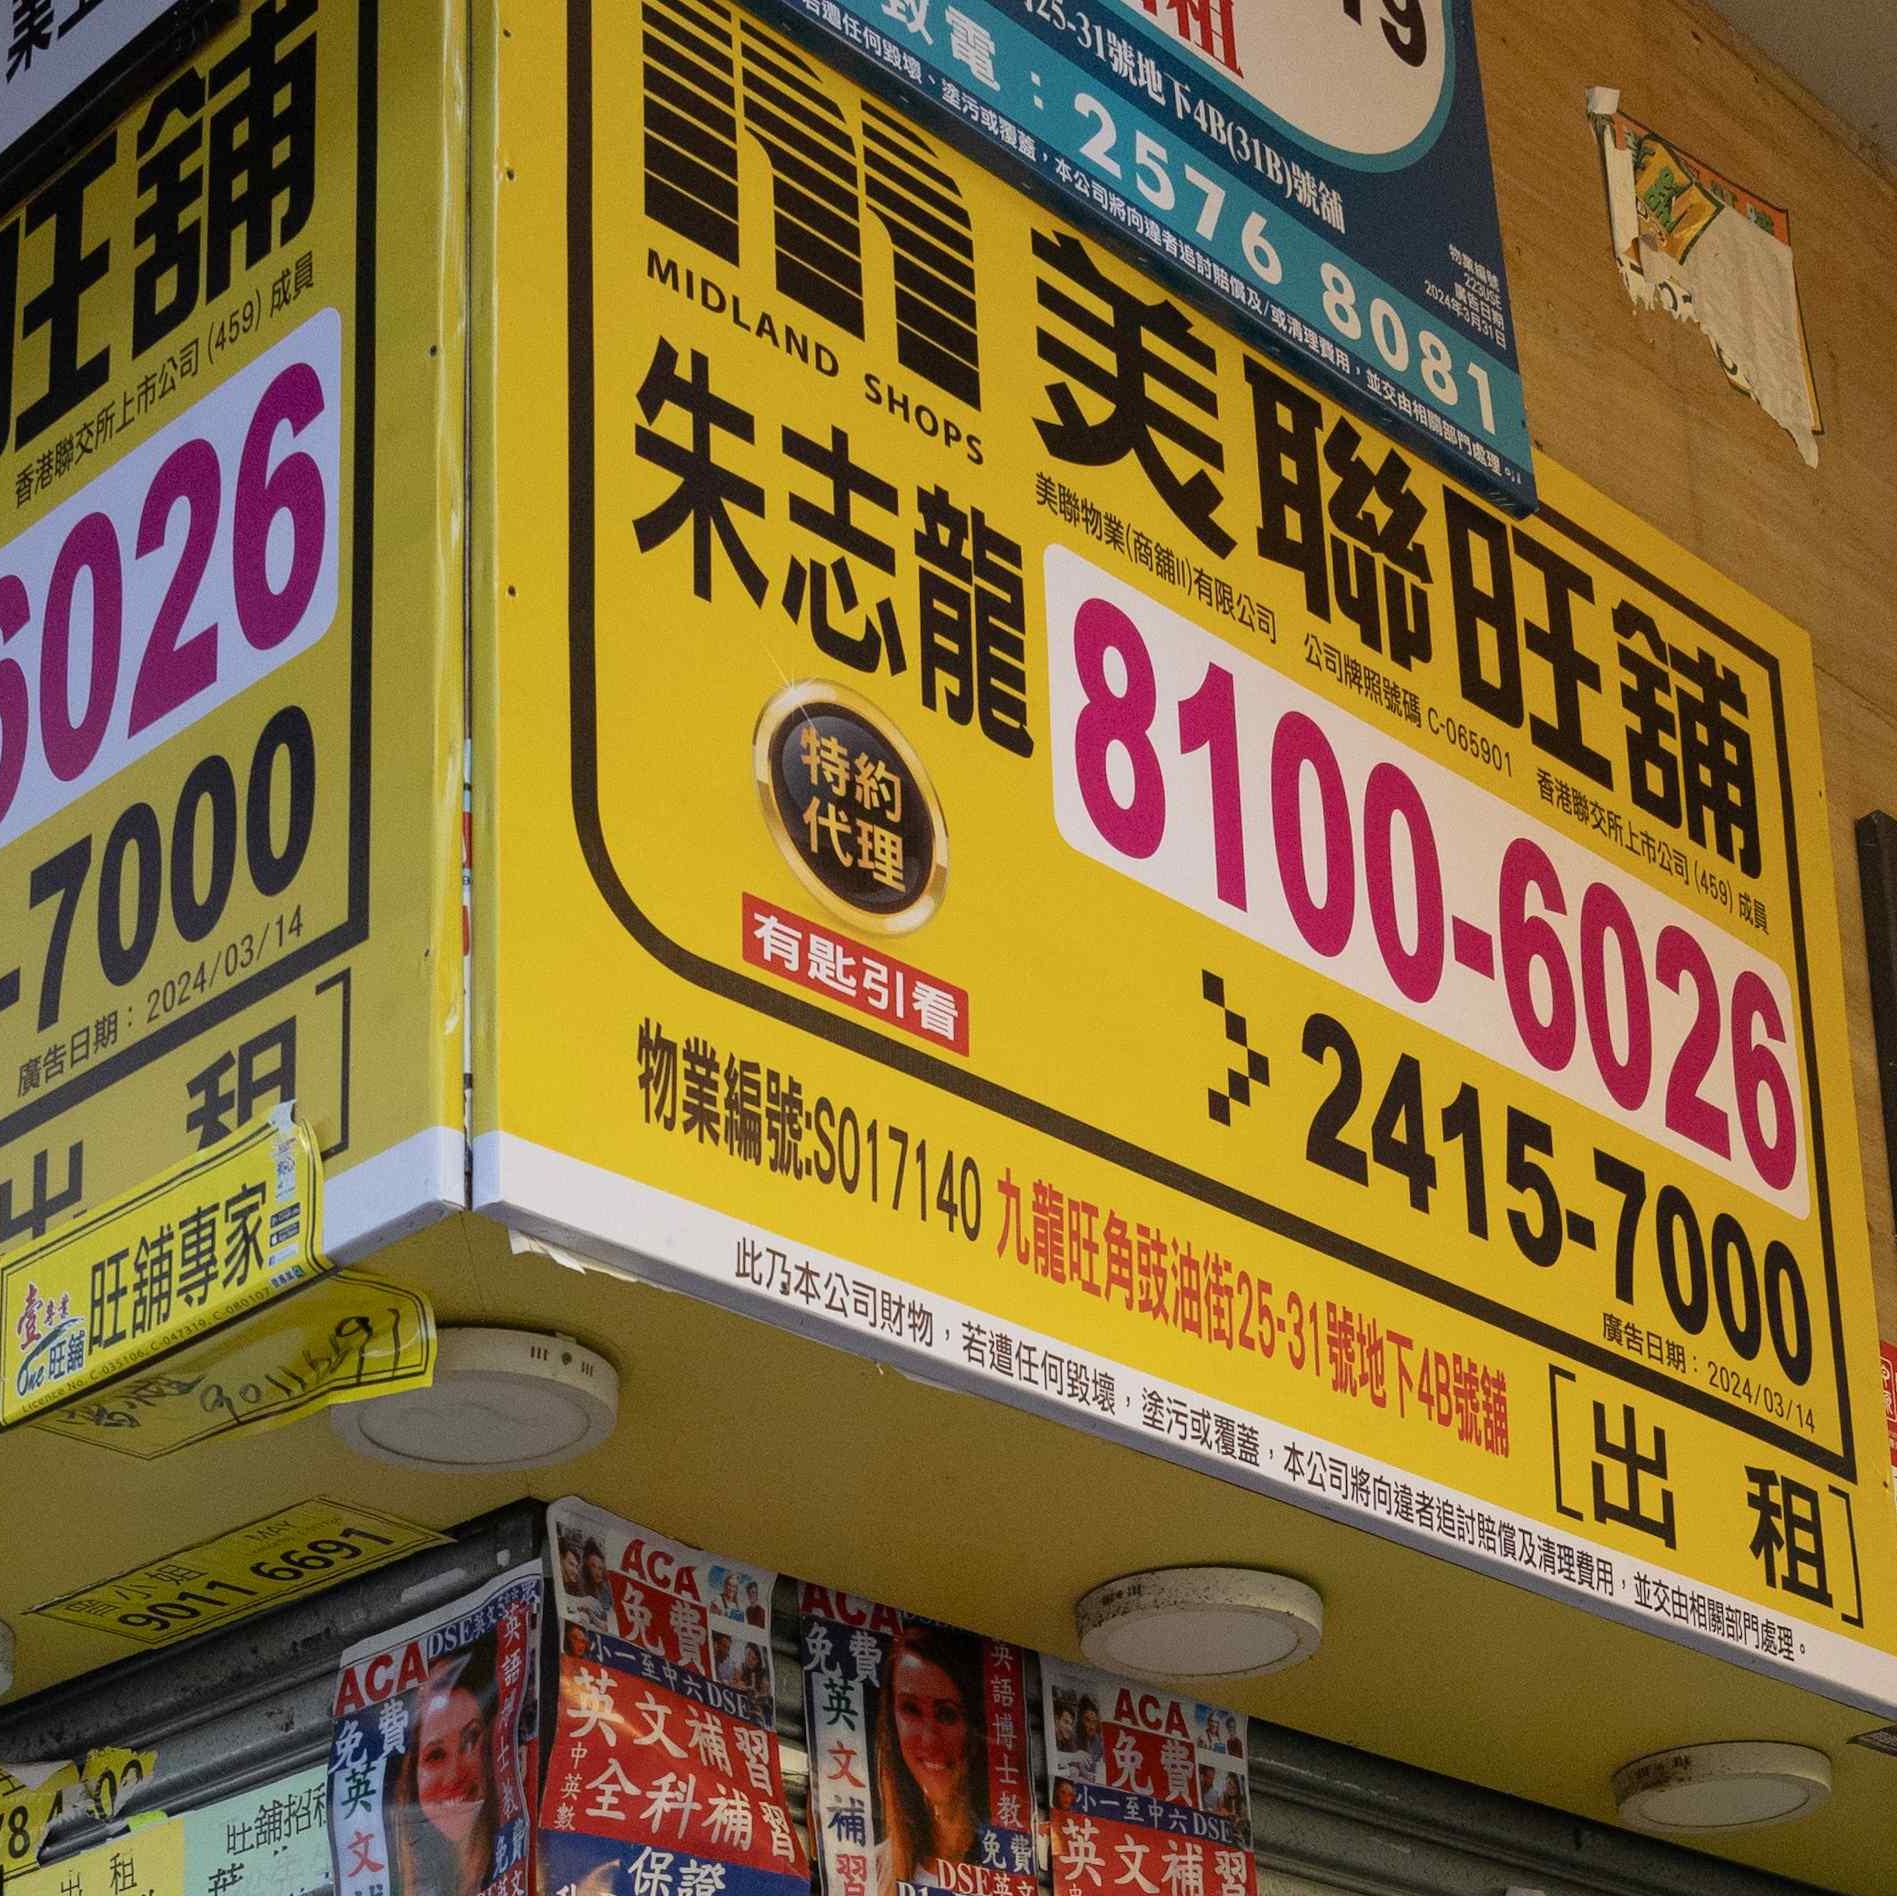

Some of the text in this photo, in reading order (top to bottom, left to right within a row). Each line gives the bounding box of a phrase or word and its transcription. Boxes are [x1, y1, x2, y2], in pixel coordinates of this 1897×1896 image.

[207, 251, 317, 367] (459) 成員
[1075, 92, 1497, 435] 2576 8081
[645, 247, 984, 466] MIDLAND SHOPS
[1030, 227, 1764, 880] 美聯旺舖
[632, 335, 1796, 1191] 朱志龍 8100-6026
[146, 910, 306, 1027] 2024/03/14
[753, 913, 961, 1043] 有匙引看
[1304, 1011, 1810, 1386] 2415-7000
[89, 1181, 267, 1355] 旺舖專家
[118, 1522, 393, 1631] 9011 6691
[622, 1538, 700, 1601] ACA
[333, 1641, 429, 1717] ACA
[623, 1584, 706, 1677] 免費
[567, 1667, 772, 1797] 英文補習
[1113, 1687, 1187, 1739] ACA
[553, 1742, 585, 1831] 中英數
[585, 1758, 796, 1863] 全科補習
